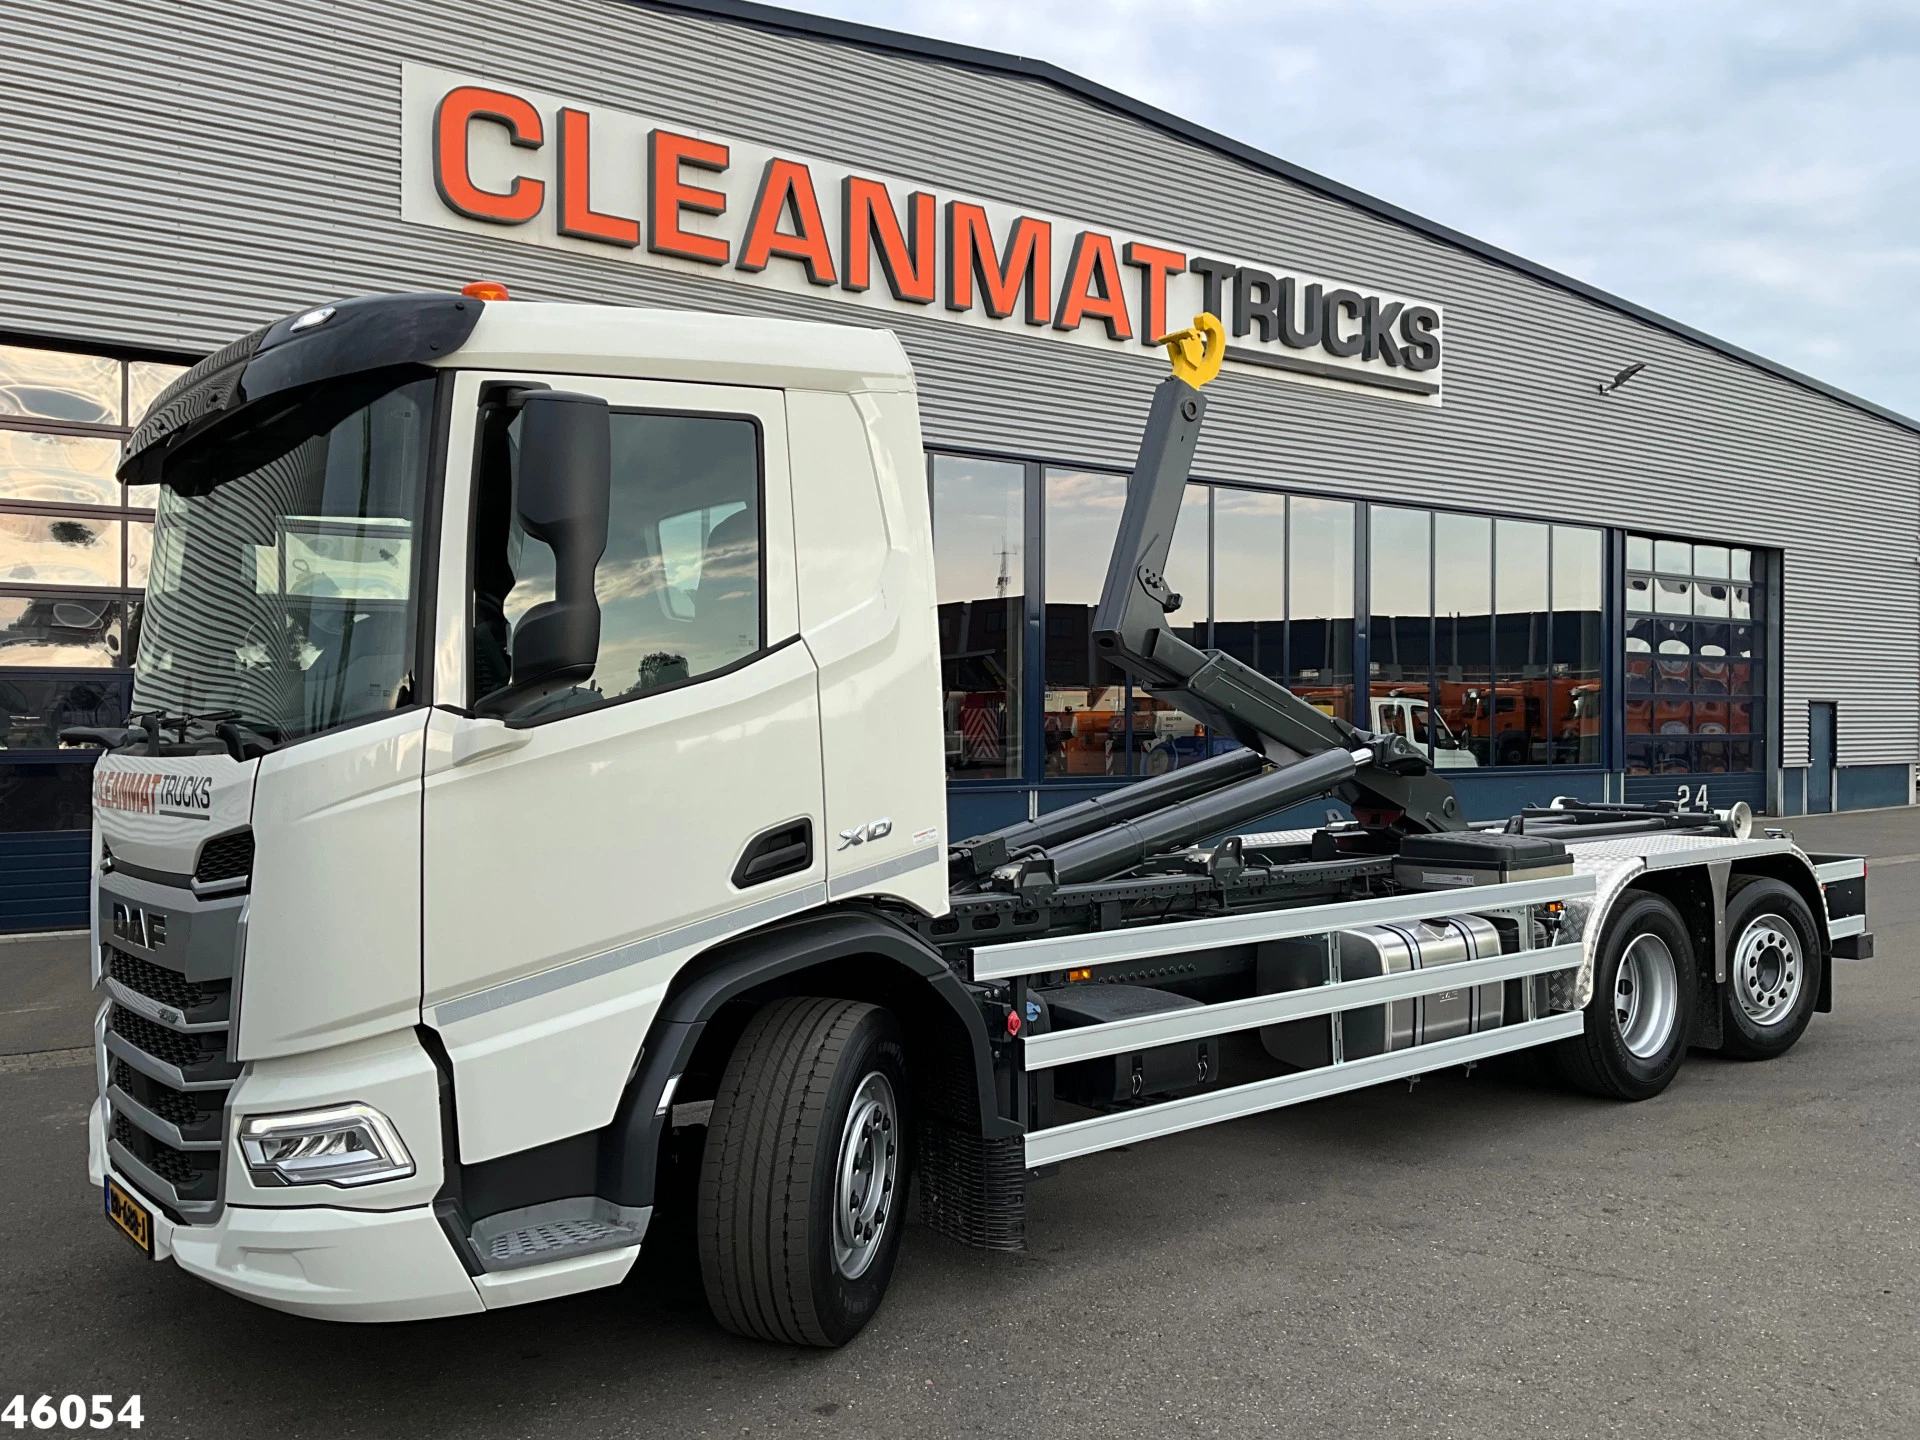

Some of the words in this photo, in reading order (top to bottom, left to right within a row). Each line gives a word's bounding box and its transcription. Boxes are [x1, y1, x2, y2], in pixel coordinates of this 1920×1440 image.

[433, 86, 1187, 347] CLEANMAT
[1190, 256, 1440, 371] TRUCKS
[159, 774, 212, 809] TRUCKS
[1677, 784, 1709, 813] 24
[837, 817, 893, 851] XD
[113, 901, 167, 952] DAF
